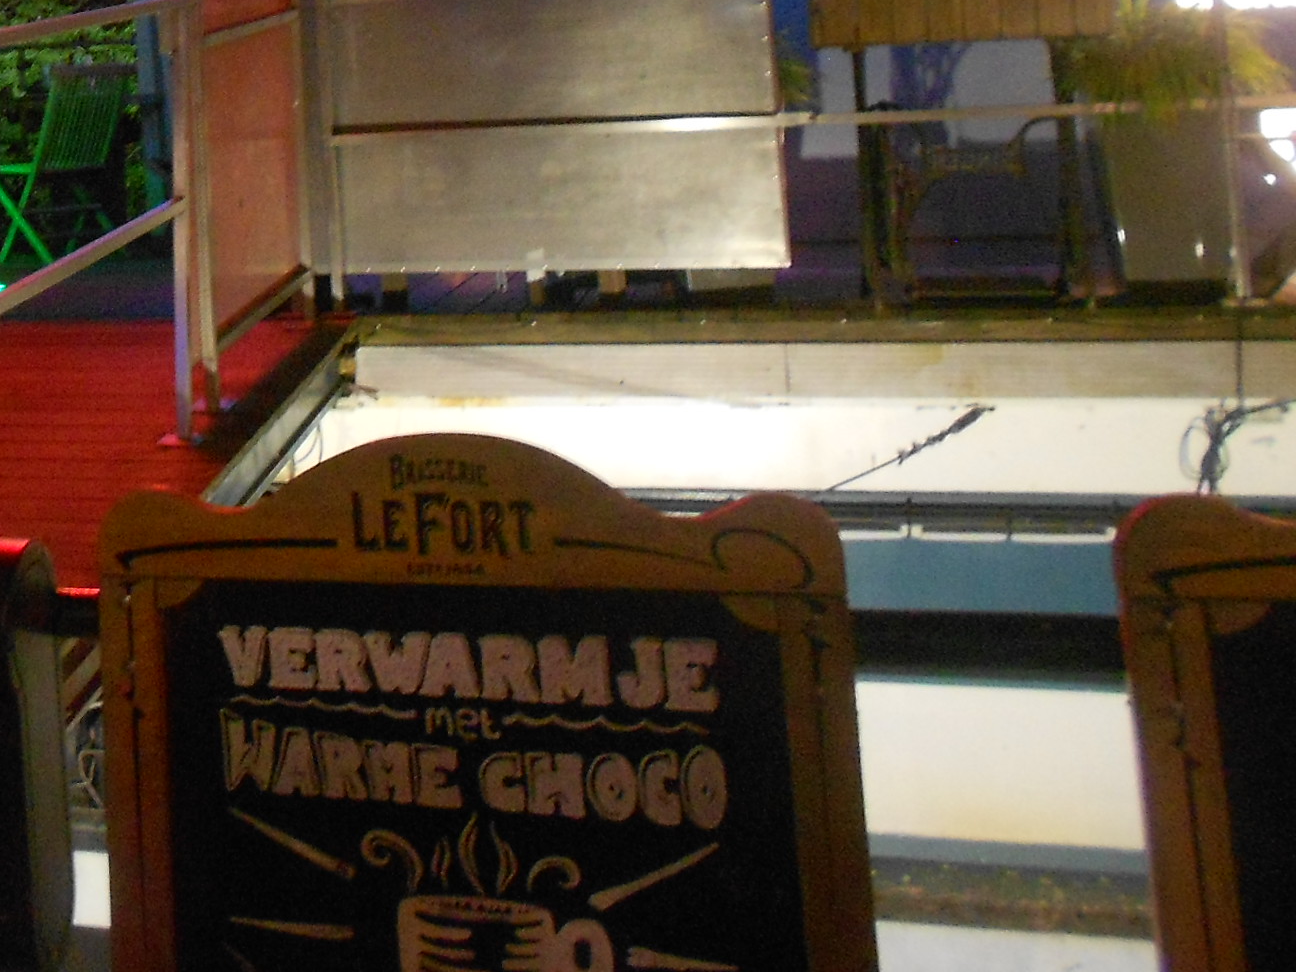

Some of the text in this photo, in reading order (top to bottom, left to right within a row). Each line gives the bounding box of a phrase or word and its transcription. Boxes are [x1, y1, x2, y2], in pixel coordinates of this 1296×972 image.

[217, 625, 721, 713] VERWARM JE
[478, 744, 729, 830] CHOCO
